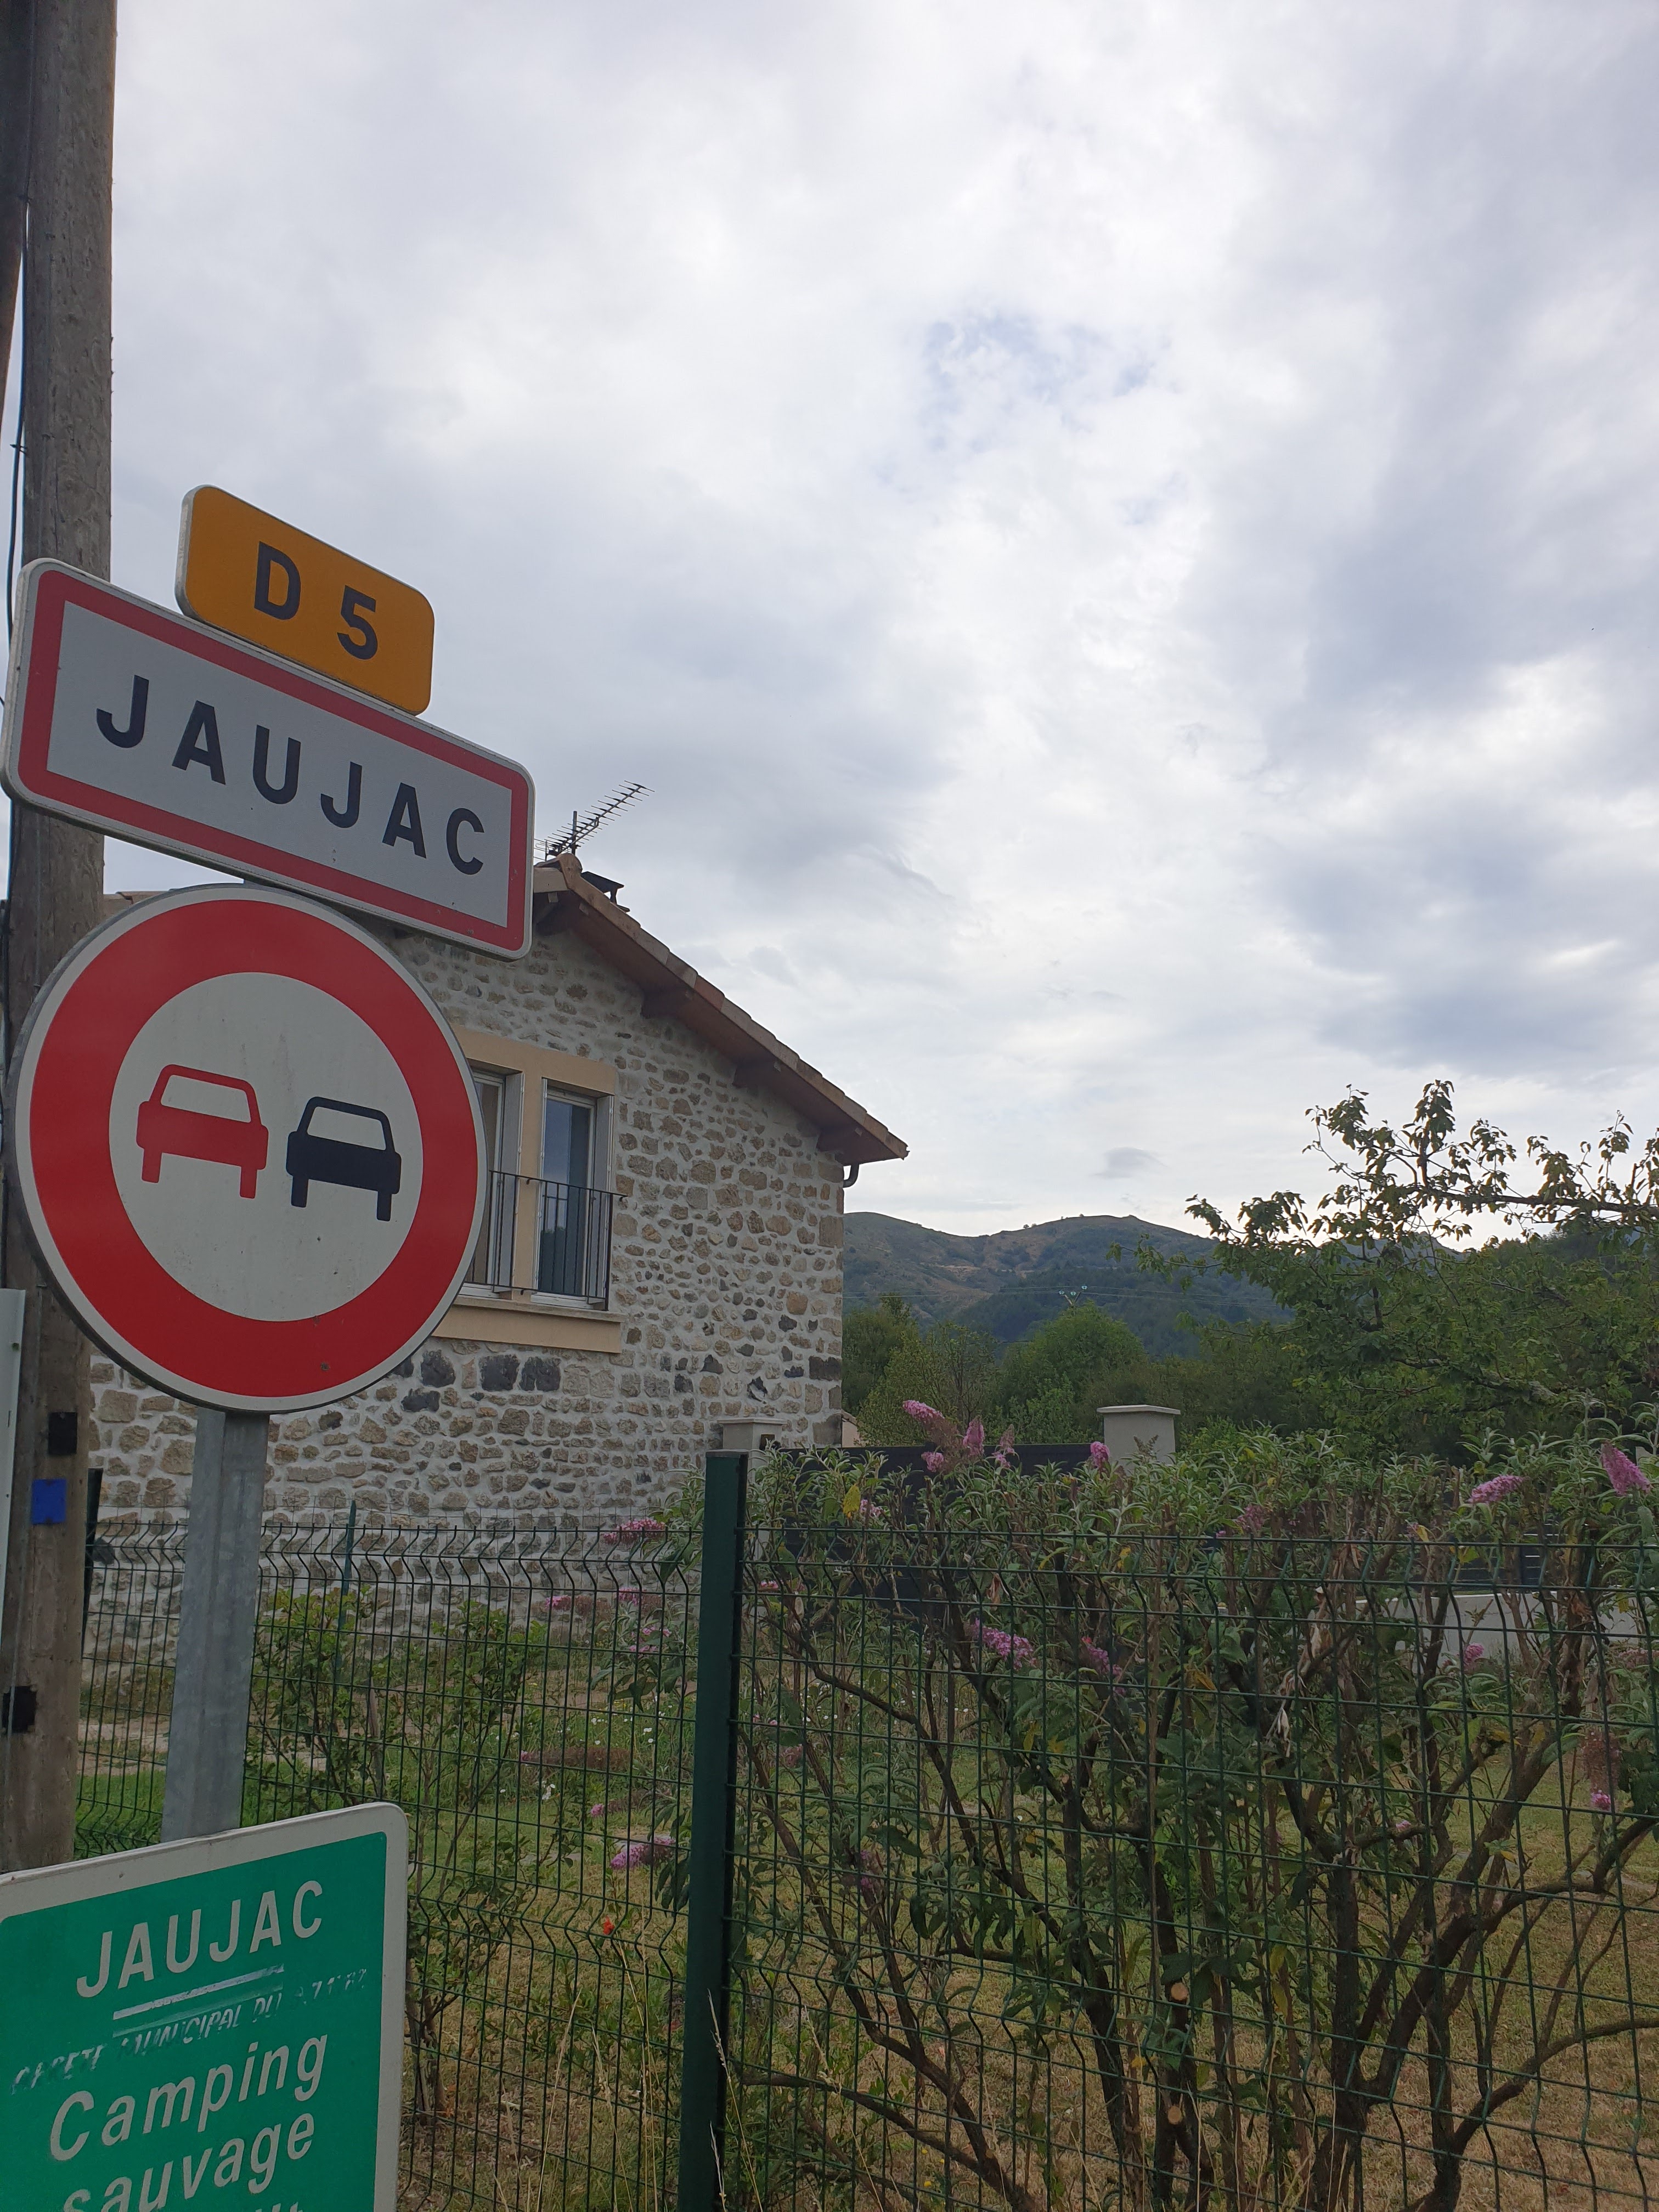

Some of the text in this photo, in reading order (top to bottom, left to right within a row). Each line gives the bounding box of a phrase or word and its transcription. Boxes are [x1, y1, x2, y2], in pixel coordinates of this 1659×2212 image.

[254, 541, 379, 660] D 5
[96, 674, 485, 876] JAUJAC
[76, 1880, 323, 1998] JAUJAC
[50, 2034, 328, 2161] Camping
